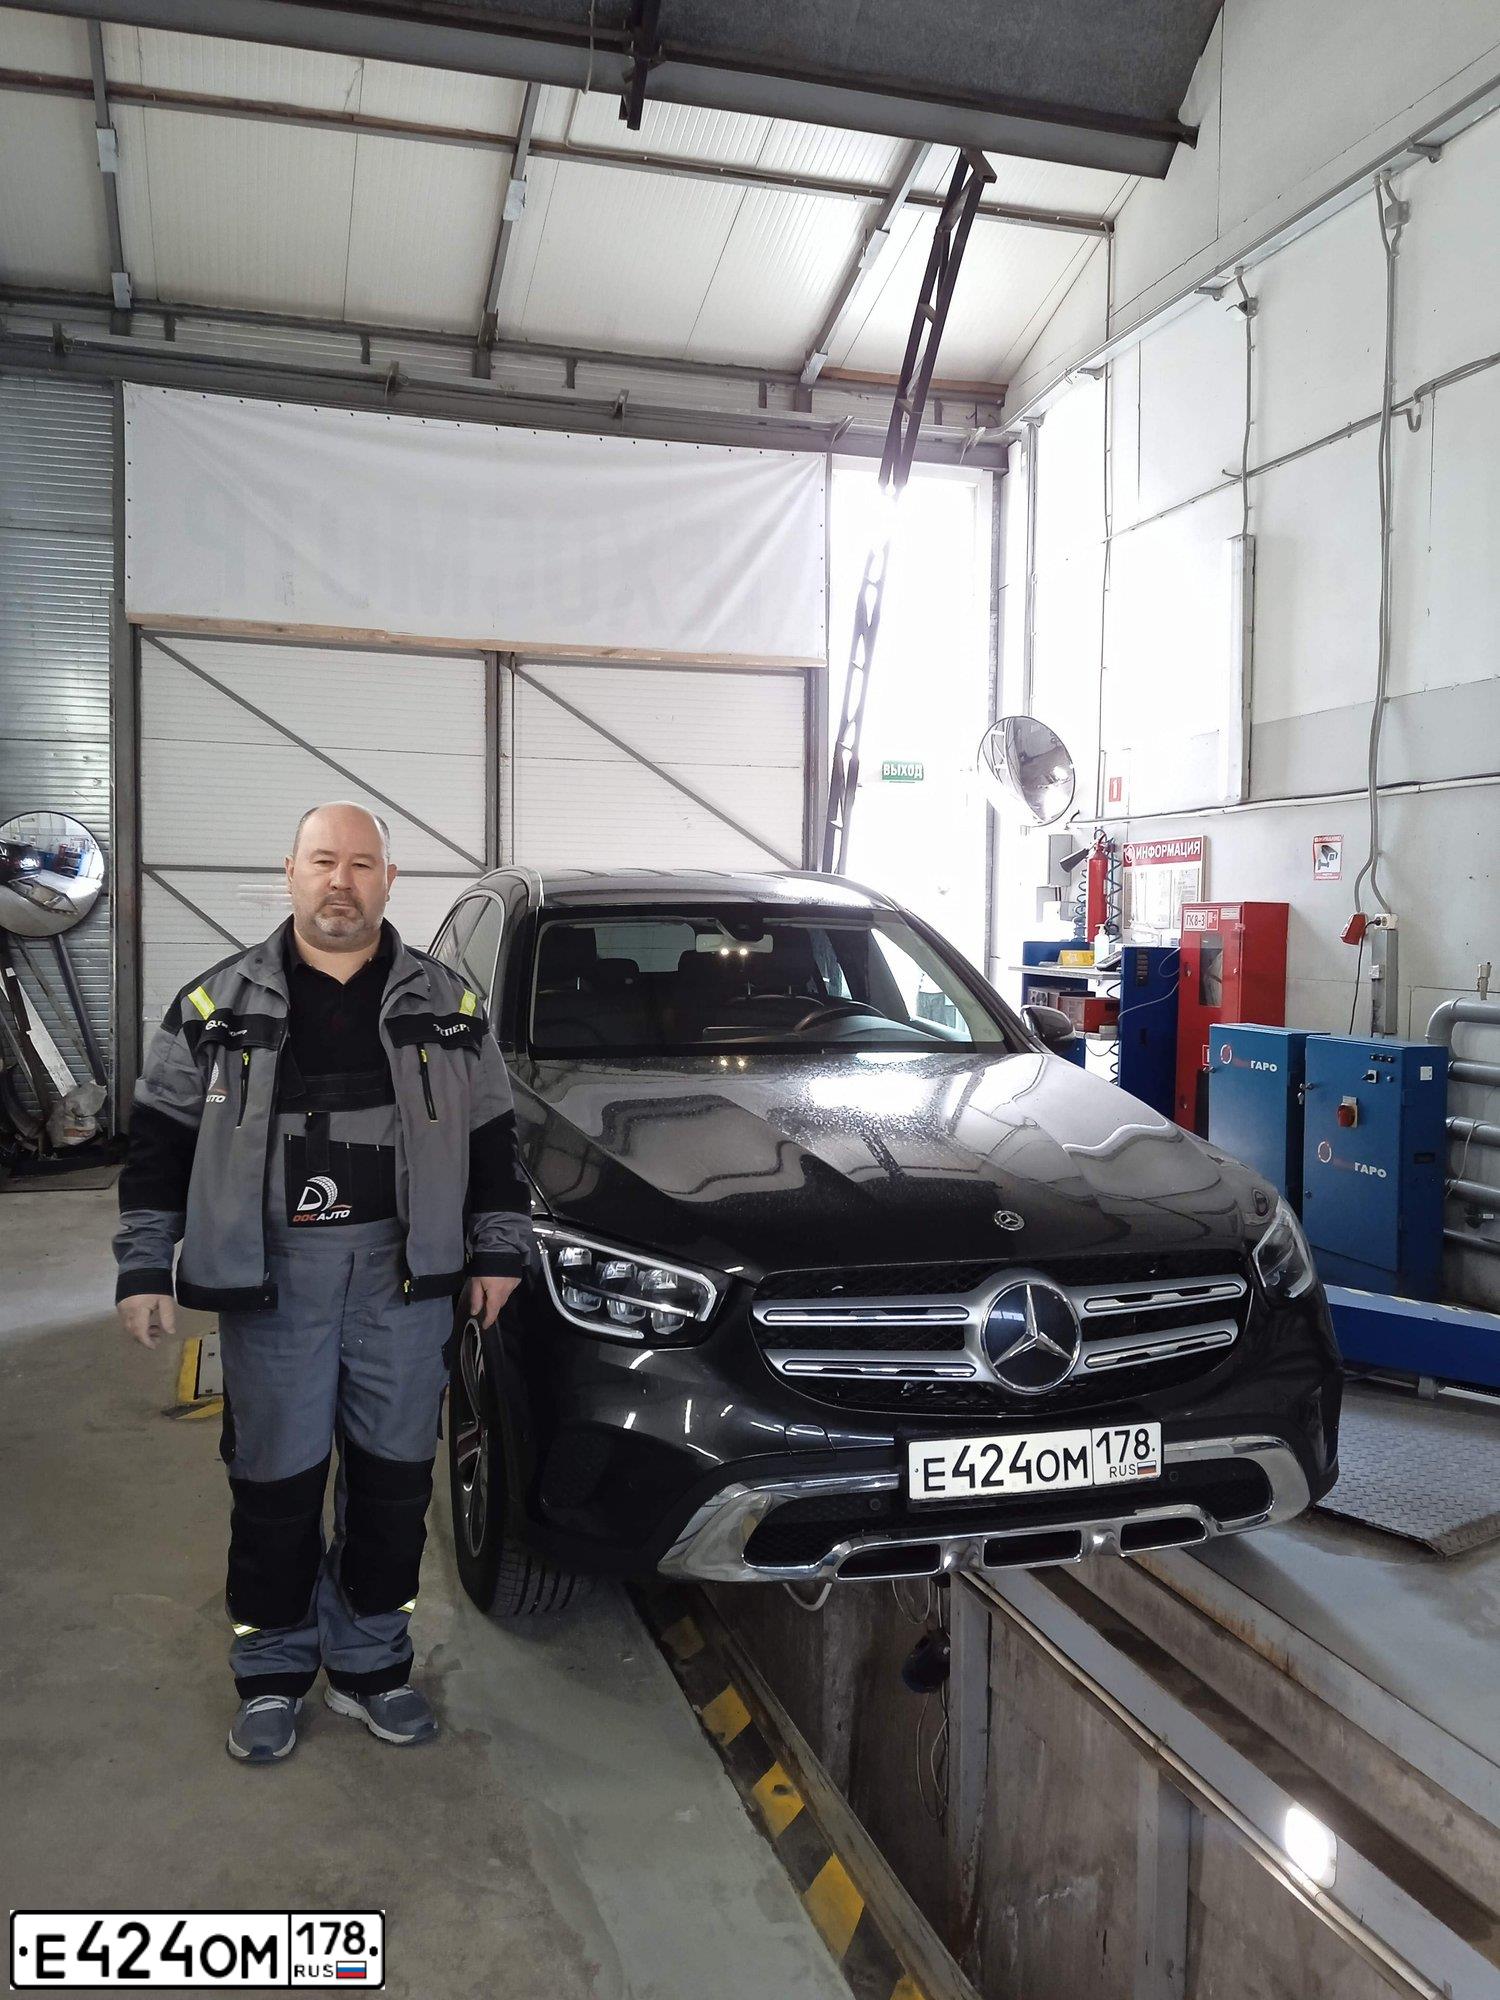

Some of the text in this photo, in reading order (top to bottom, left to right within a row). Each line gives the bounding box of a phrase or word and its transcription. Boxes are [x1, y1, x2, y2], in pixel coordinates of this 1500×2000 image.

[883, 764, 923, 779] ВЫХОД
[1136, 841, 1201, 860] ИНФОРМАЦИЯ
[923, 1428, 1150, 1492] Е424ОМ 178
[1109, 1463, 1136, 1478] RUS
